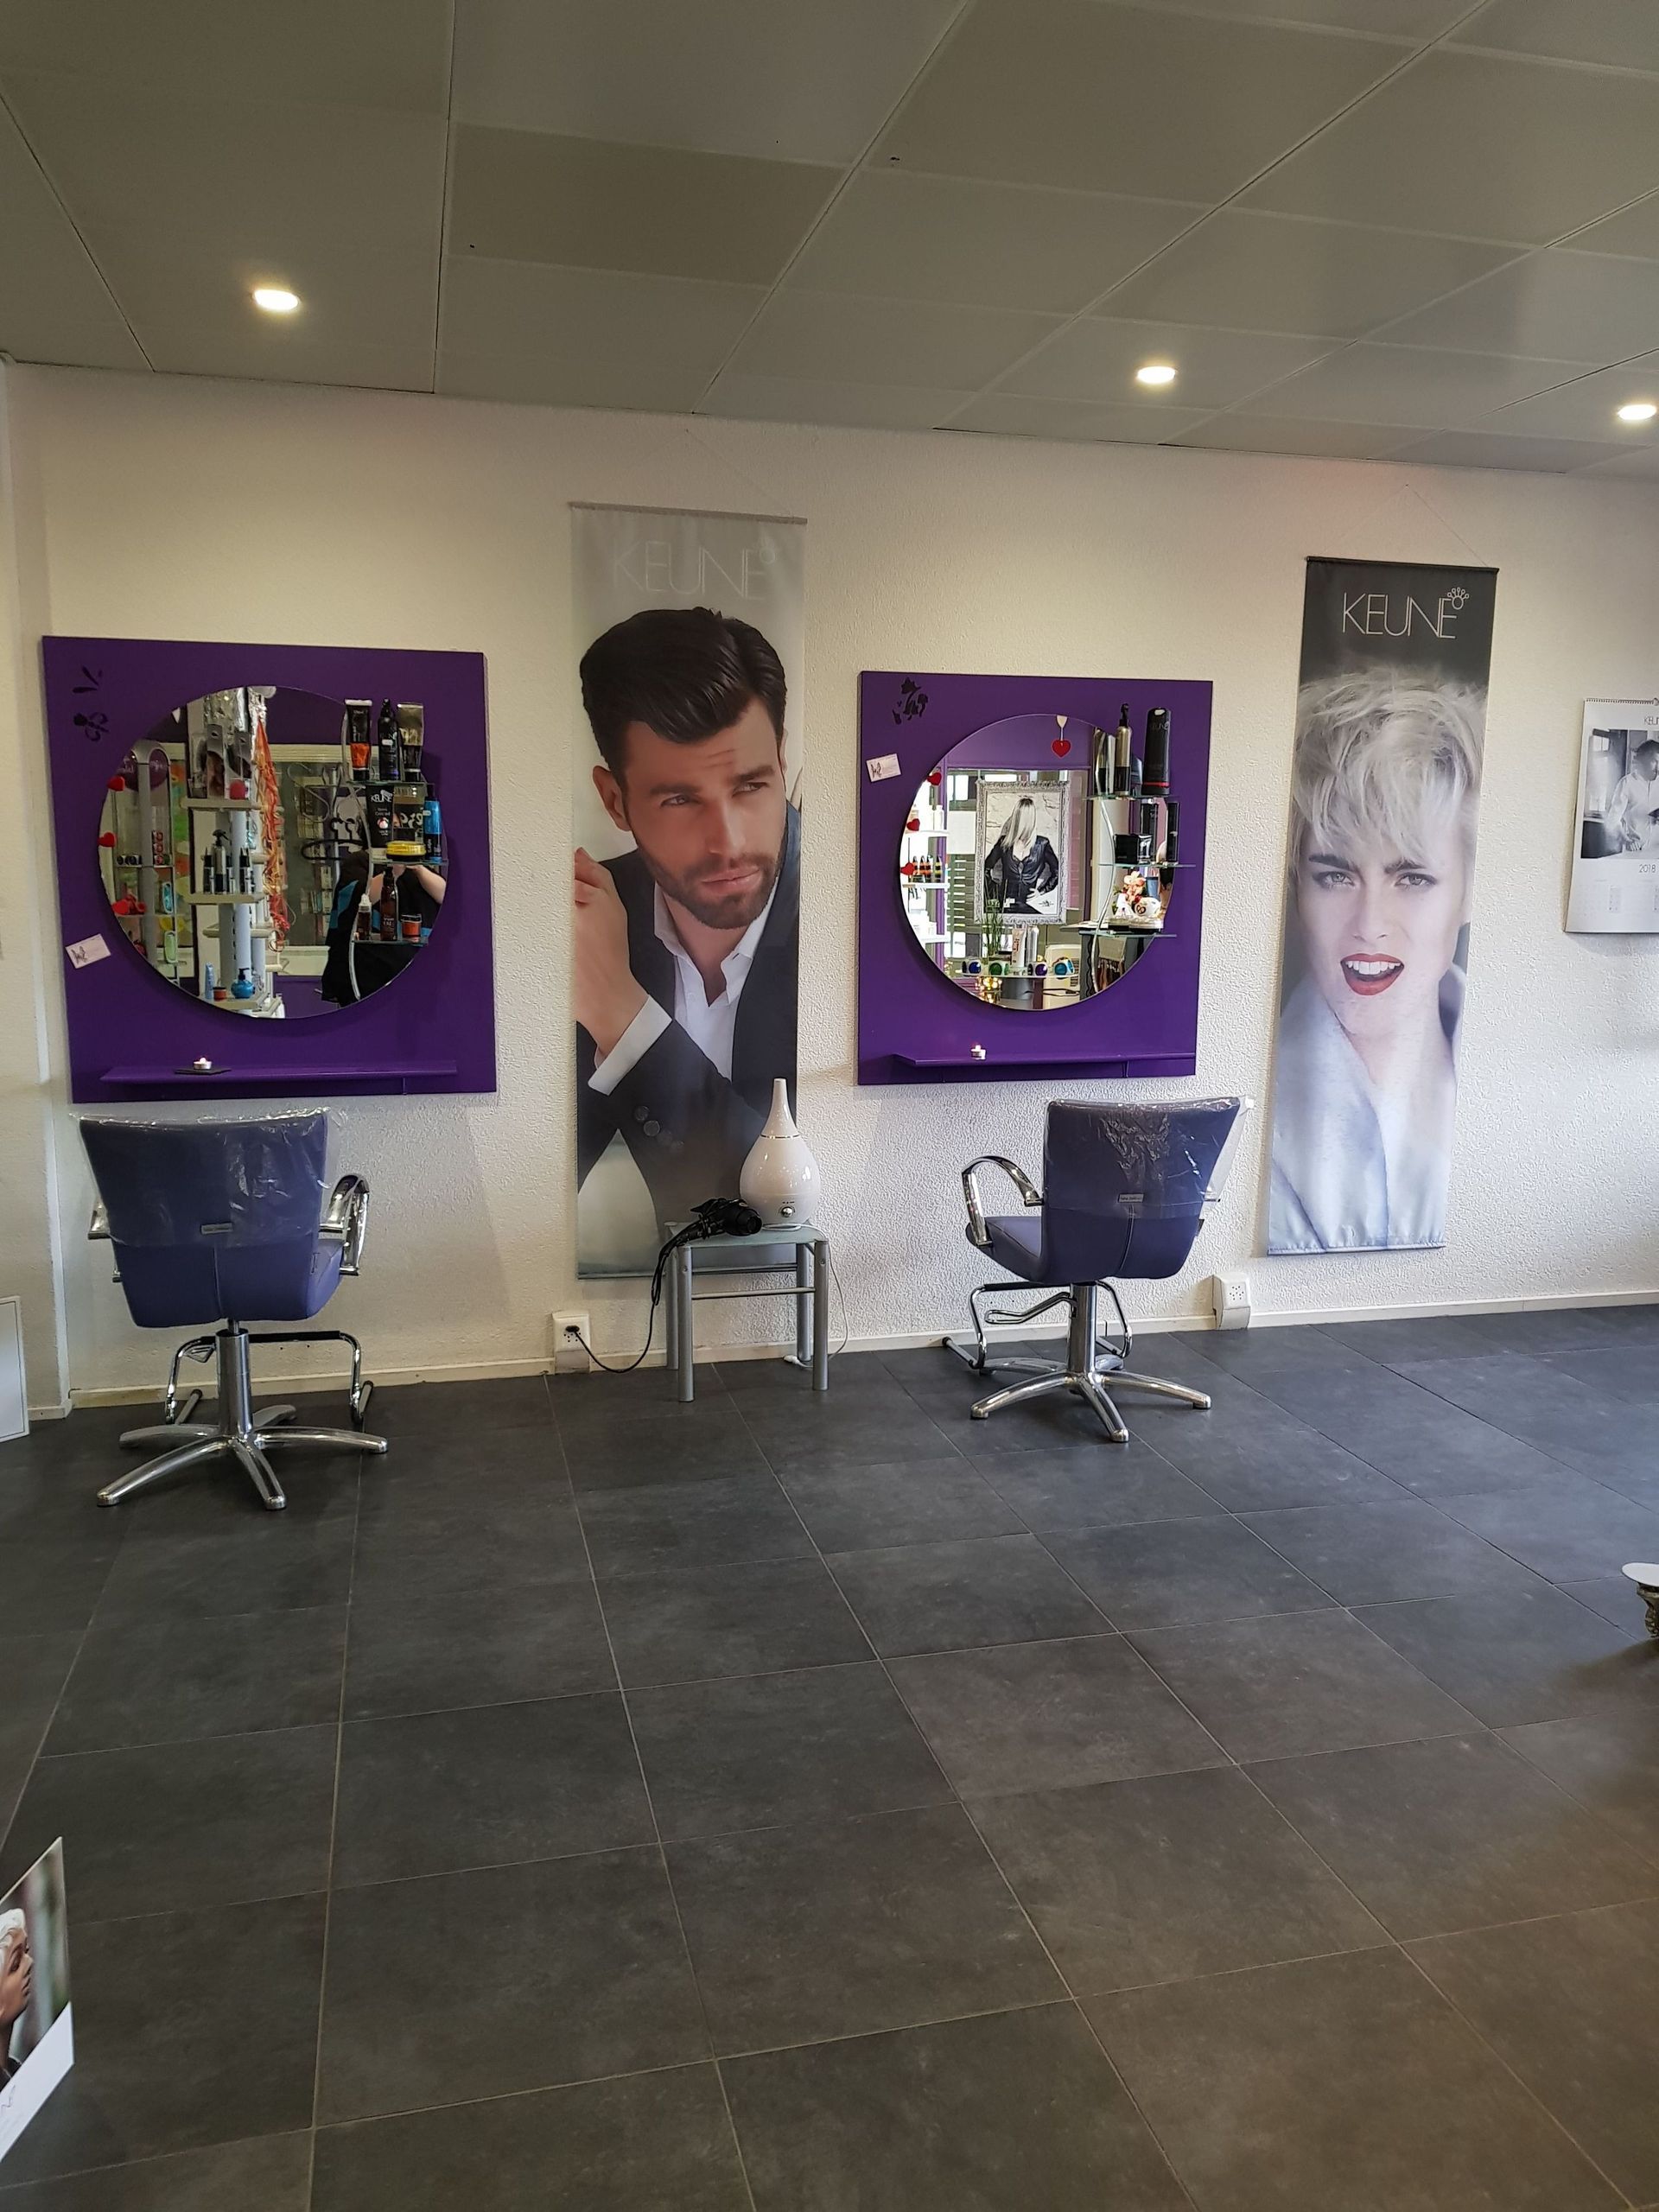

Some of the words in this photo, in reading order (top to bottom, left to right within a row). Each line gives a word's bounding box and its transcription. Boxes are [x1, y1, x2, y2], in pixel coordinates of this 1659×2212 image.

[613, 538, 766, 601] KEUNE
[1343, 592, 1457, 639] KEUNE
[1638, 863, 1657, 874] 2018
